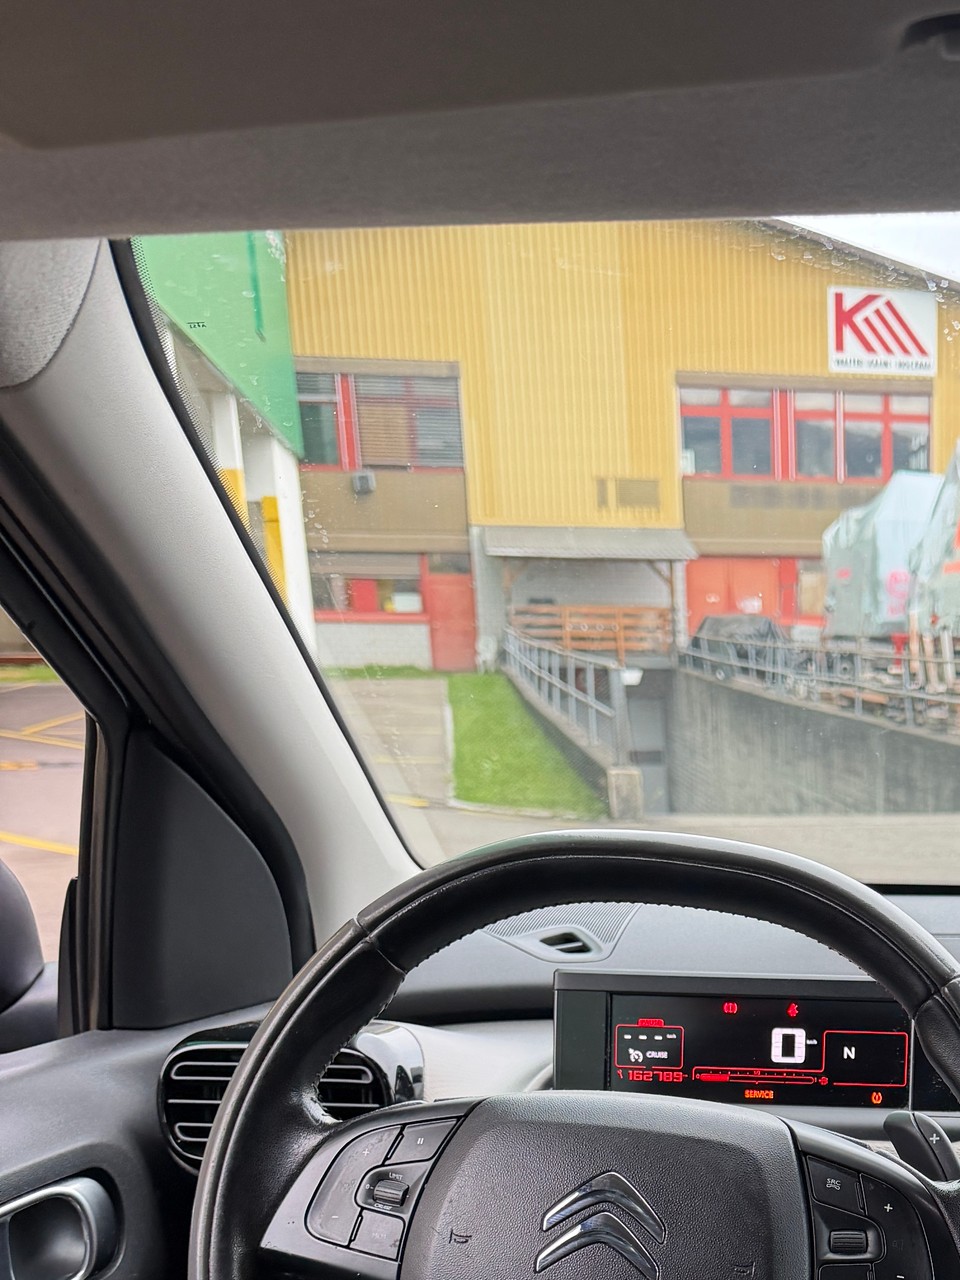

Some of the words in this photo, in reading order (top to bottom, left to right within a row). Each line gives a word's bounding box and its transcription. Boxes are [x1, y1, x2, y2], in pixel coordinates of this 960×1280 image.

[843, 1046, 856, 1060] N
[627, 1070, 683, 1083] 162789
[744, 1089, 774, 1099] SERVICE
[826, 1178, 841, 1186] SRC
